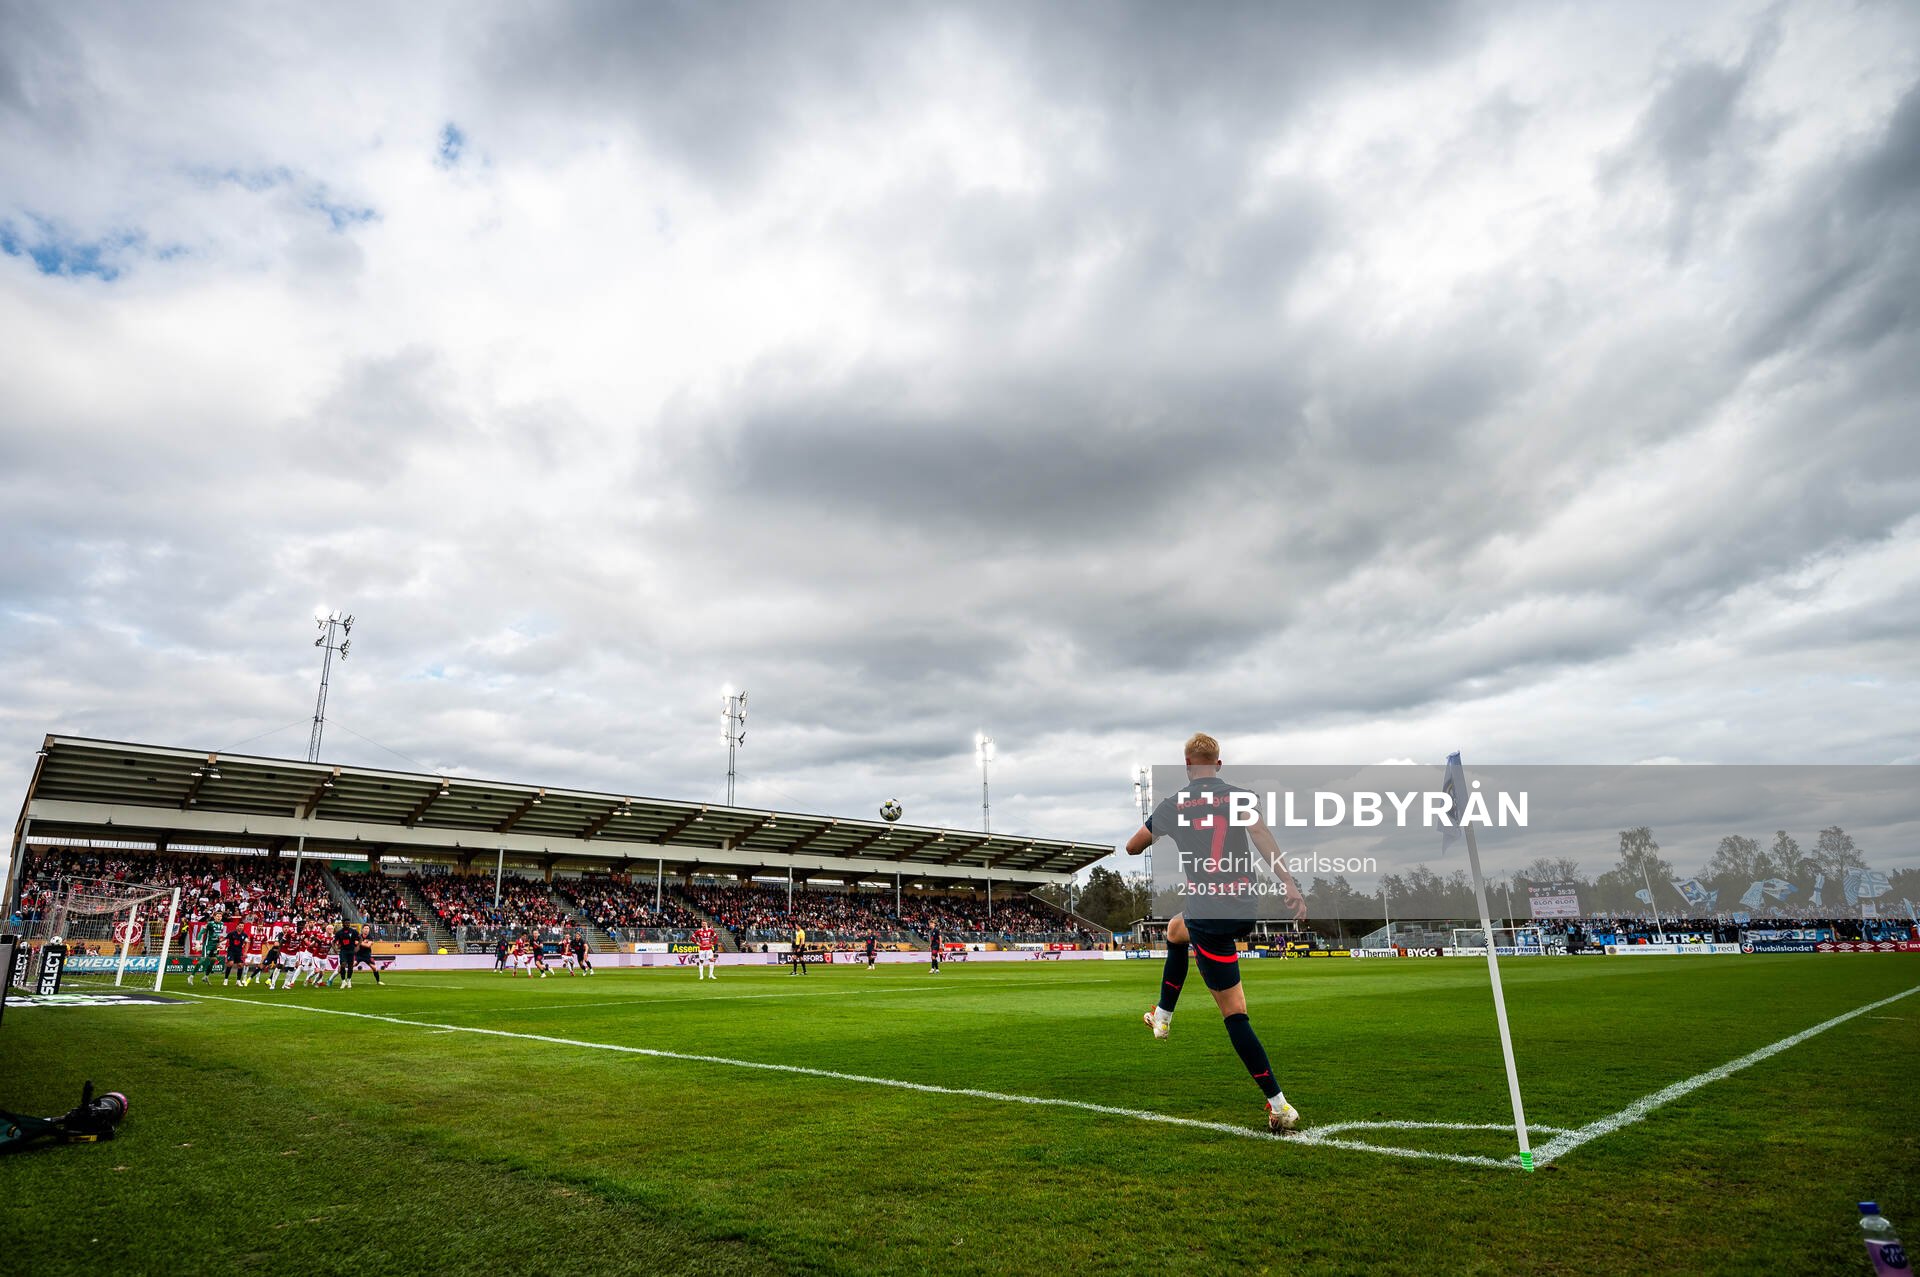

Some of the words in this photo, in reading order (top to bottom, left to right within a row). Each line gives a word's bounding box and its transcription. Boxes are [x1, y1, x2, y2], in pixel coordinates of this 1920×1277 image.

[1684, 945, 1702, 953] real
[1718, 944, 1736, 952] real
[1755, 944, 1814, 953] Husbilslandet
[1362, 949, 1397, 958] Thermia
[1407, 948, 1438, 958] BYGG
[66, 957, 158, 968] SWEDSKÄR
[40, 951, 62, 995] SELECT
